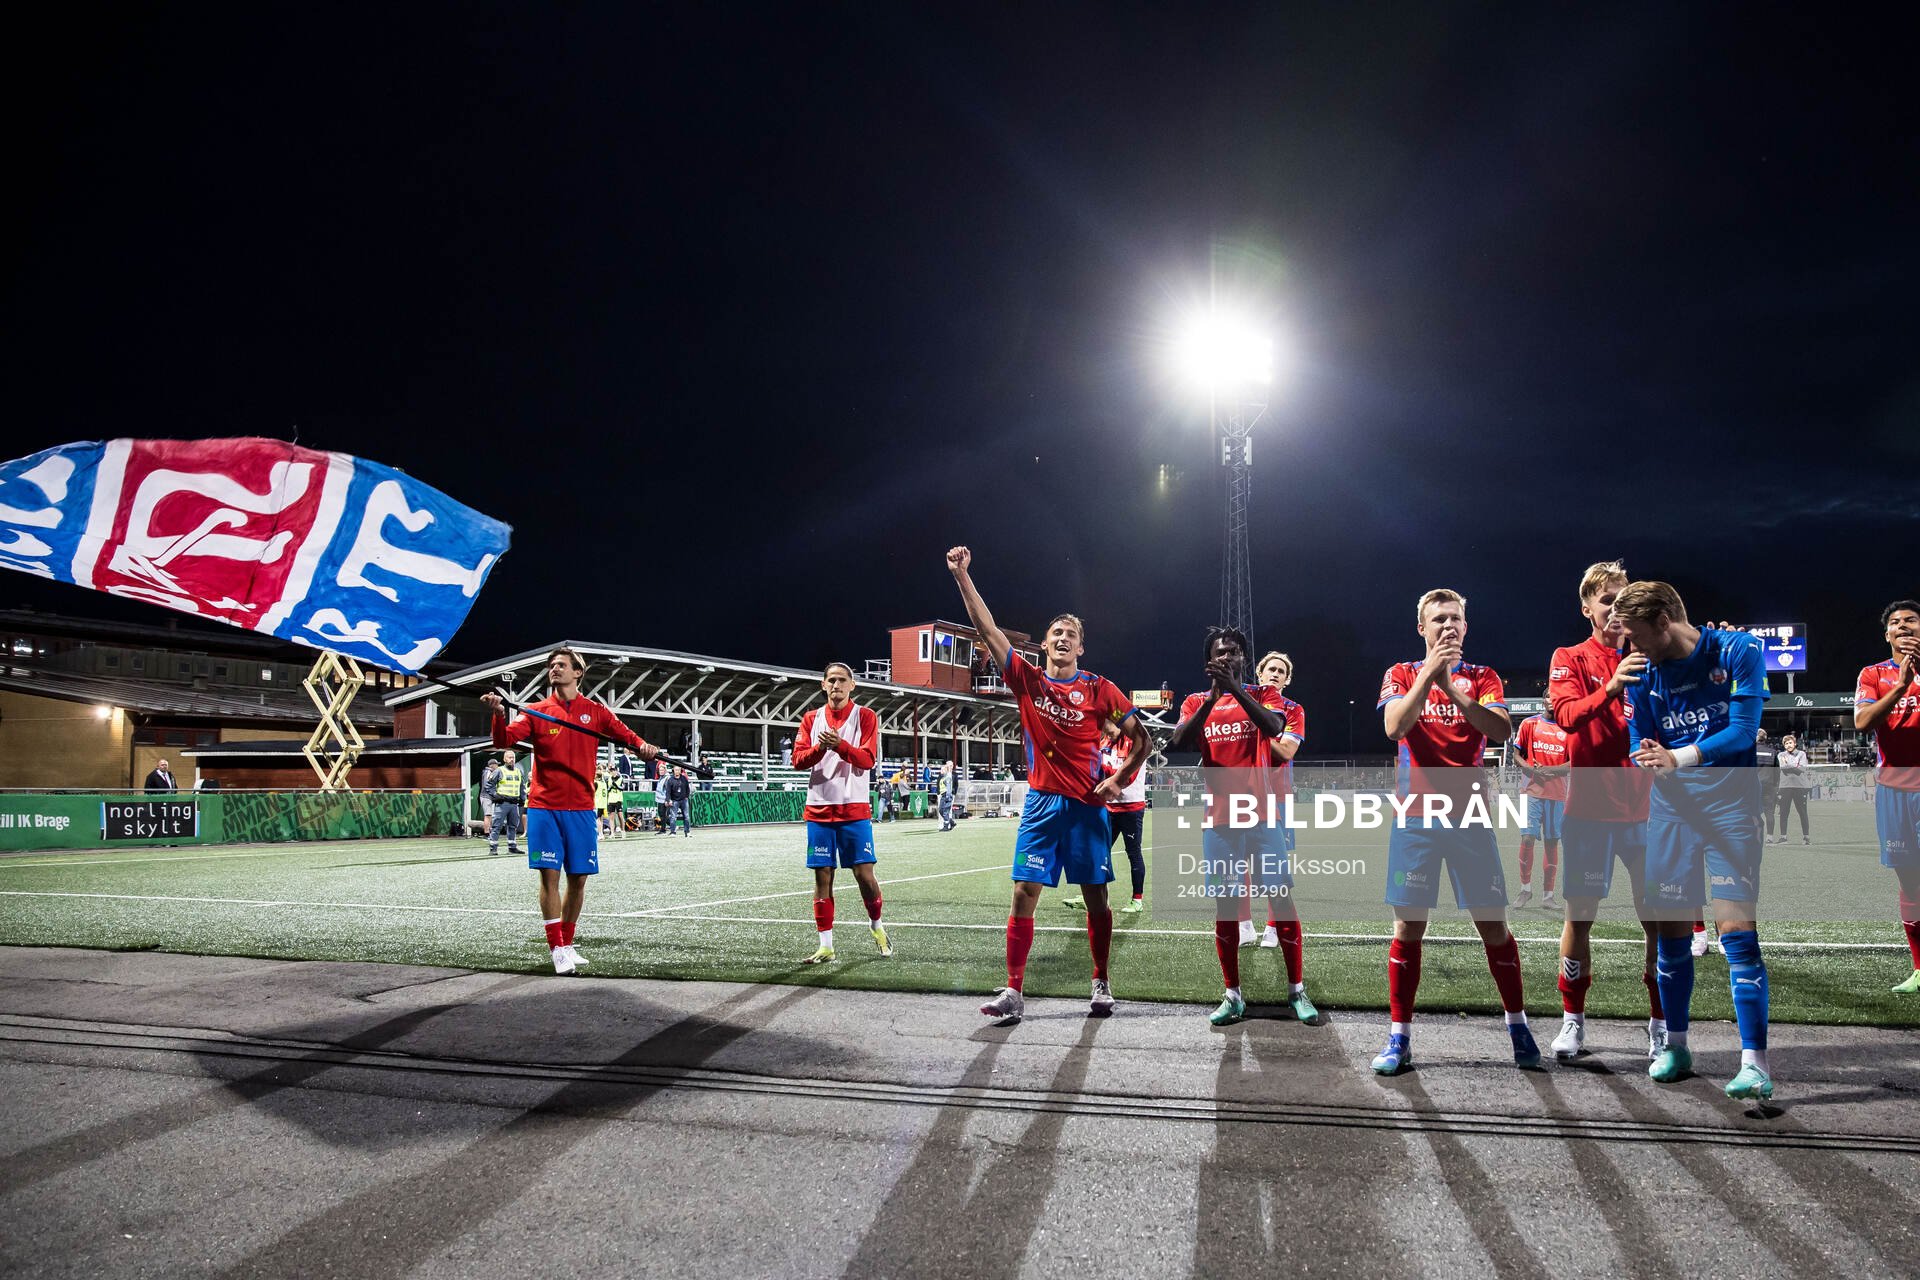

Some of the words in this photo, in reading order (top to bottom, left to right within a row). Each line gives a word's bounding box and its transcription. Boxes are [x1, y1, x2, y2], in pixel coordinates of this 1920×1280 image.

[1034, 696, 1068, 719] akea
[1421, 699, 1458, 717] kea
[1511, 703, 1532, 711] BRAGE
[1661, 707, 1710, 730] akea
[1204, 721, 1242, 738] akea
[1533, 740, 1555, 751] akea
[110, 802, 192, 819] norling
[18, 813, 32, 828] IK
[34, 814, 71, 831] Brage
[124, 820, 180, 837] skylt
[1027, 854, 1044, 865] Solid
[1406, 872, 1427, 882] Solid
[1584, 872, 1604, 880] Solid
[1659, 883, 1682, 894] Solid
